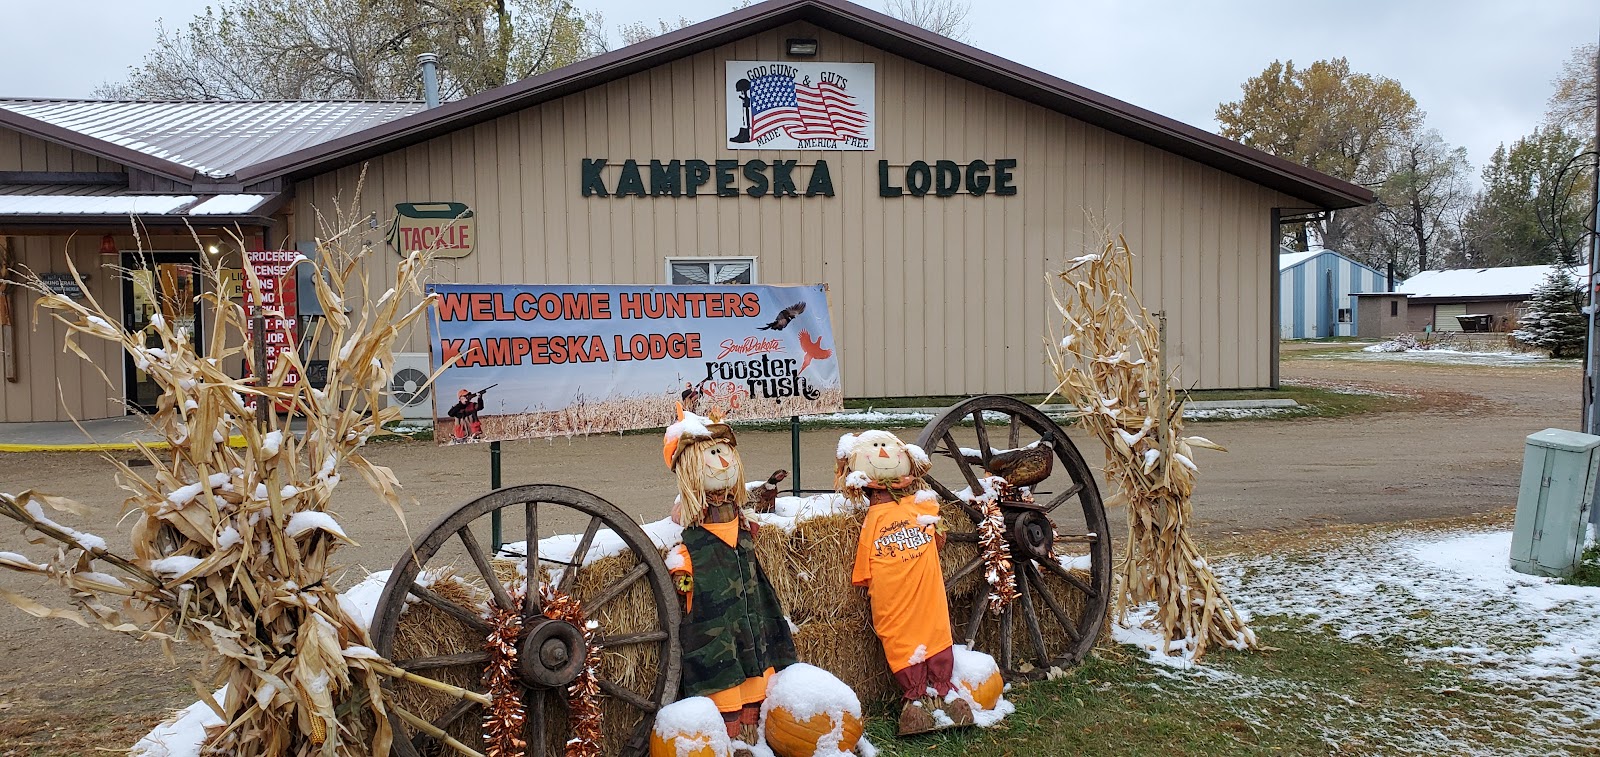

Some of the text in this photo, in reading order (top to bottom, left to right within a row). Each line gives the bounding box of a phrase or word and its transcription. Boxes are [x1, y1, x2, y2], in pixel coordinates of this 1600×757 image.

[747, 64, 848, 89] GOD GUNS & GUTS
[756, 128, 869, 149] MADE AMERICA FREE
[581, 158, 1017, 198] KAMPESKA LODGE
[400, 225, 470, 251] TACKLE
[253, 265, 291, 276] ICENSES
[246, 279, 274, 290] GNS
[247, 292, 275, 303] AMO
[438, 291, 761, 322] WELCOME HUNTERS
[441, 332, 703, 368] KAMPESKA LODGE
[705, 353, 797, 381] rooster
[747, 369, 820, 404] rush
[874, 526, 920, 550] rooster
[896, 531, 933, 552] rush
